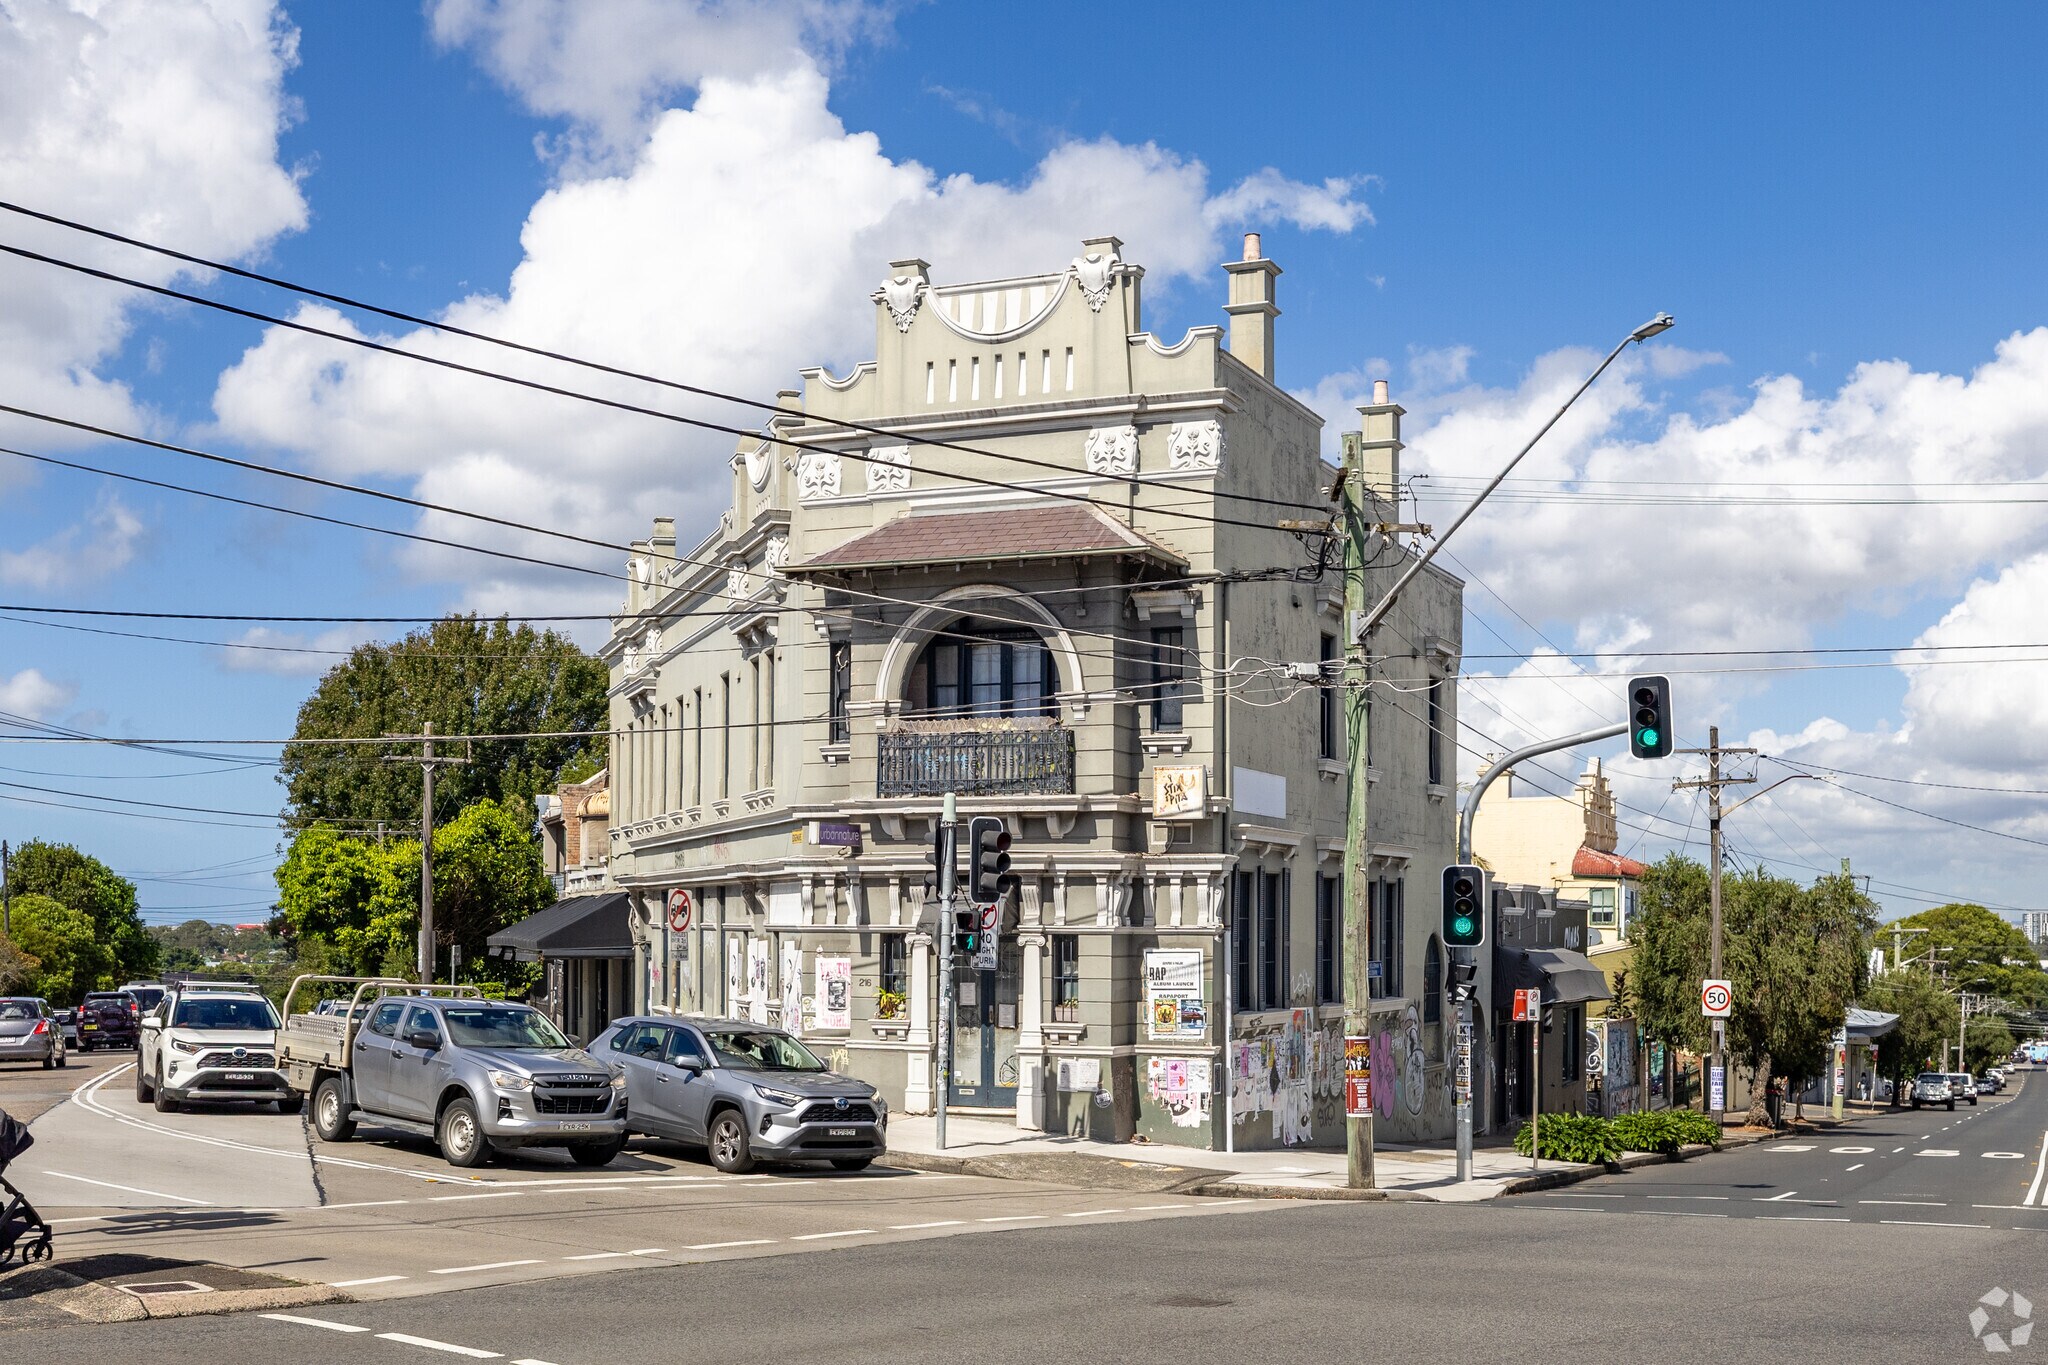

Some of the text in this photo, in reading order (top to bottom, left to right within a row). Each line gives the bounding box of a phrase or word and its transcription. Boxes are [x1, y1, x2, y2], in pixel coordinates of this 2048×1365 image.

[820, 828, 859, 841] urbannature
[859, 978, 872, 986] 216
[1708, 992, 1726, 1004] 50
[1763, 1145, 2025, 1159] 50 50
